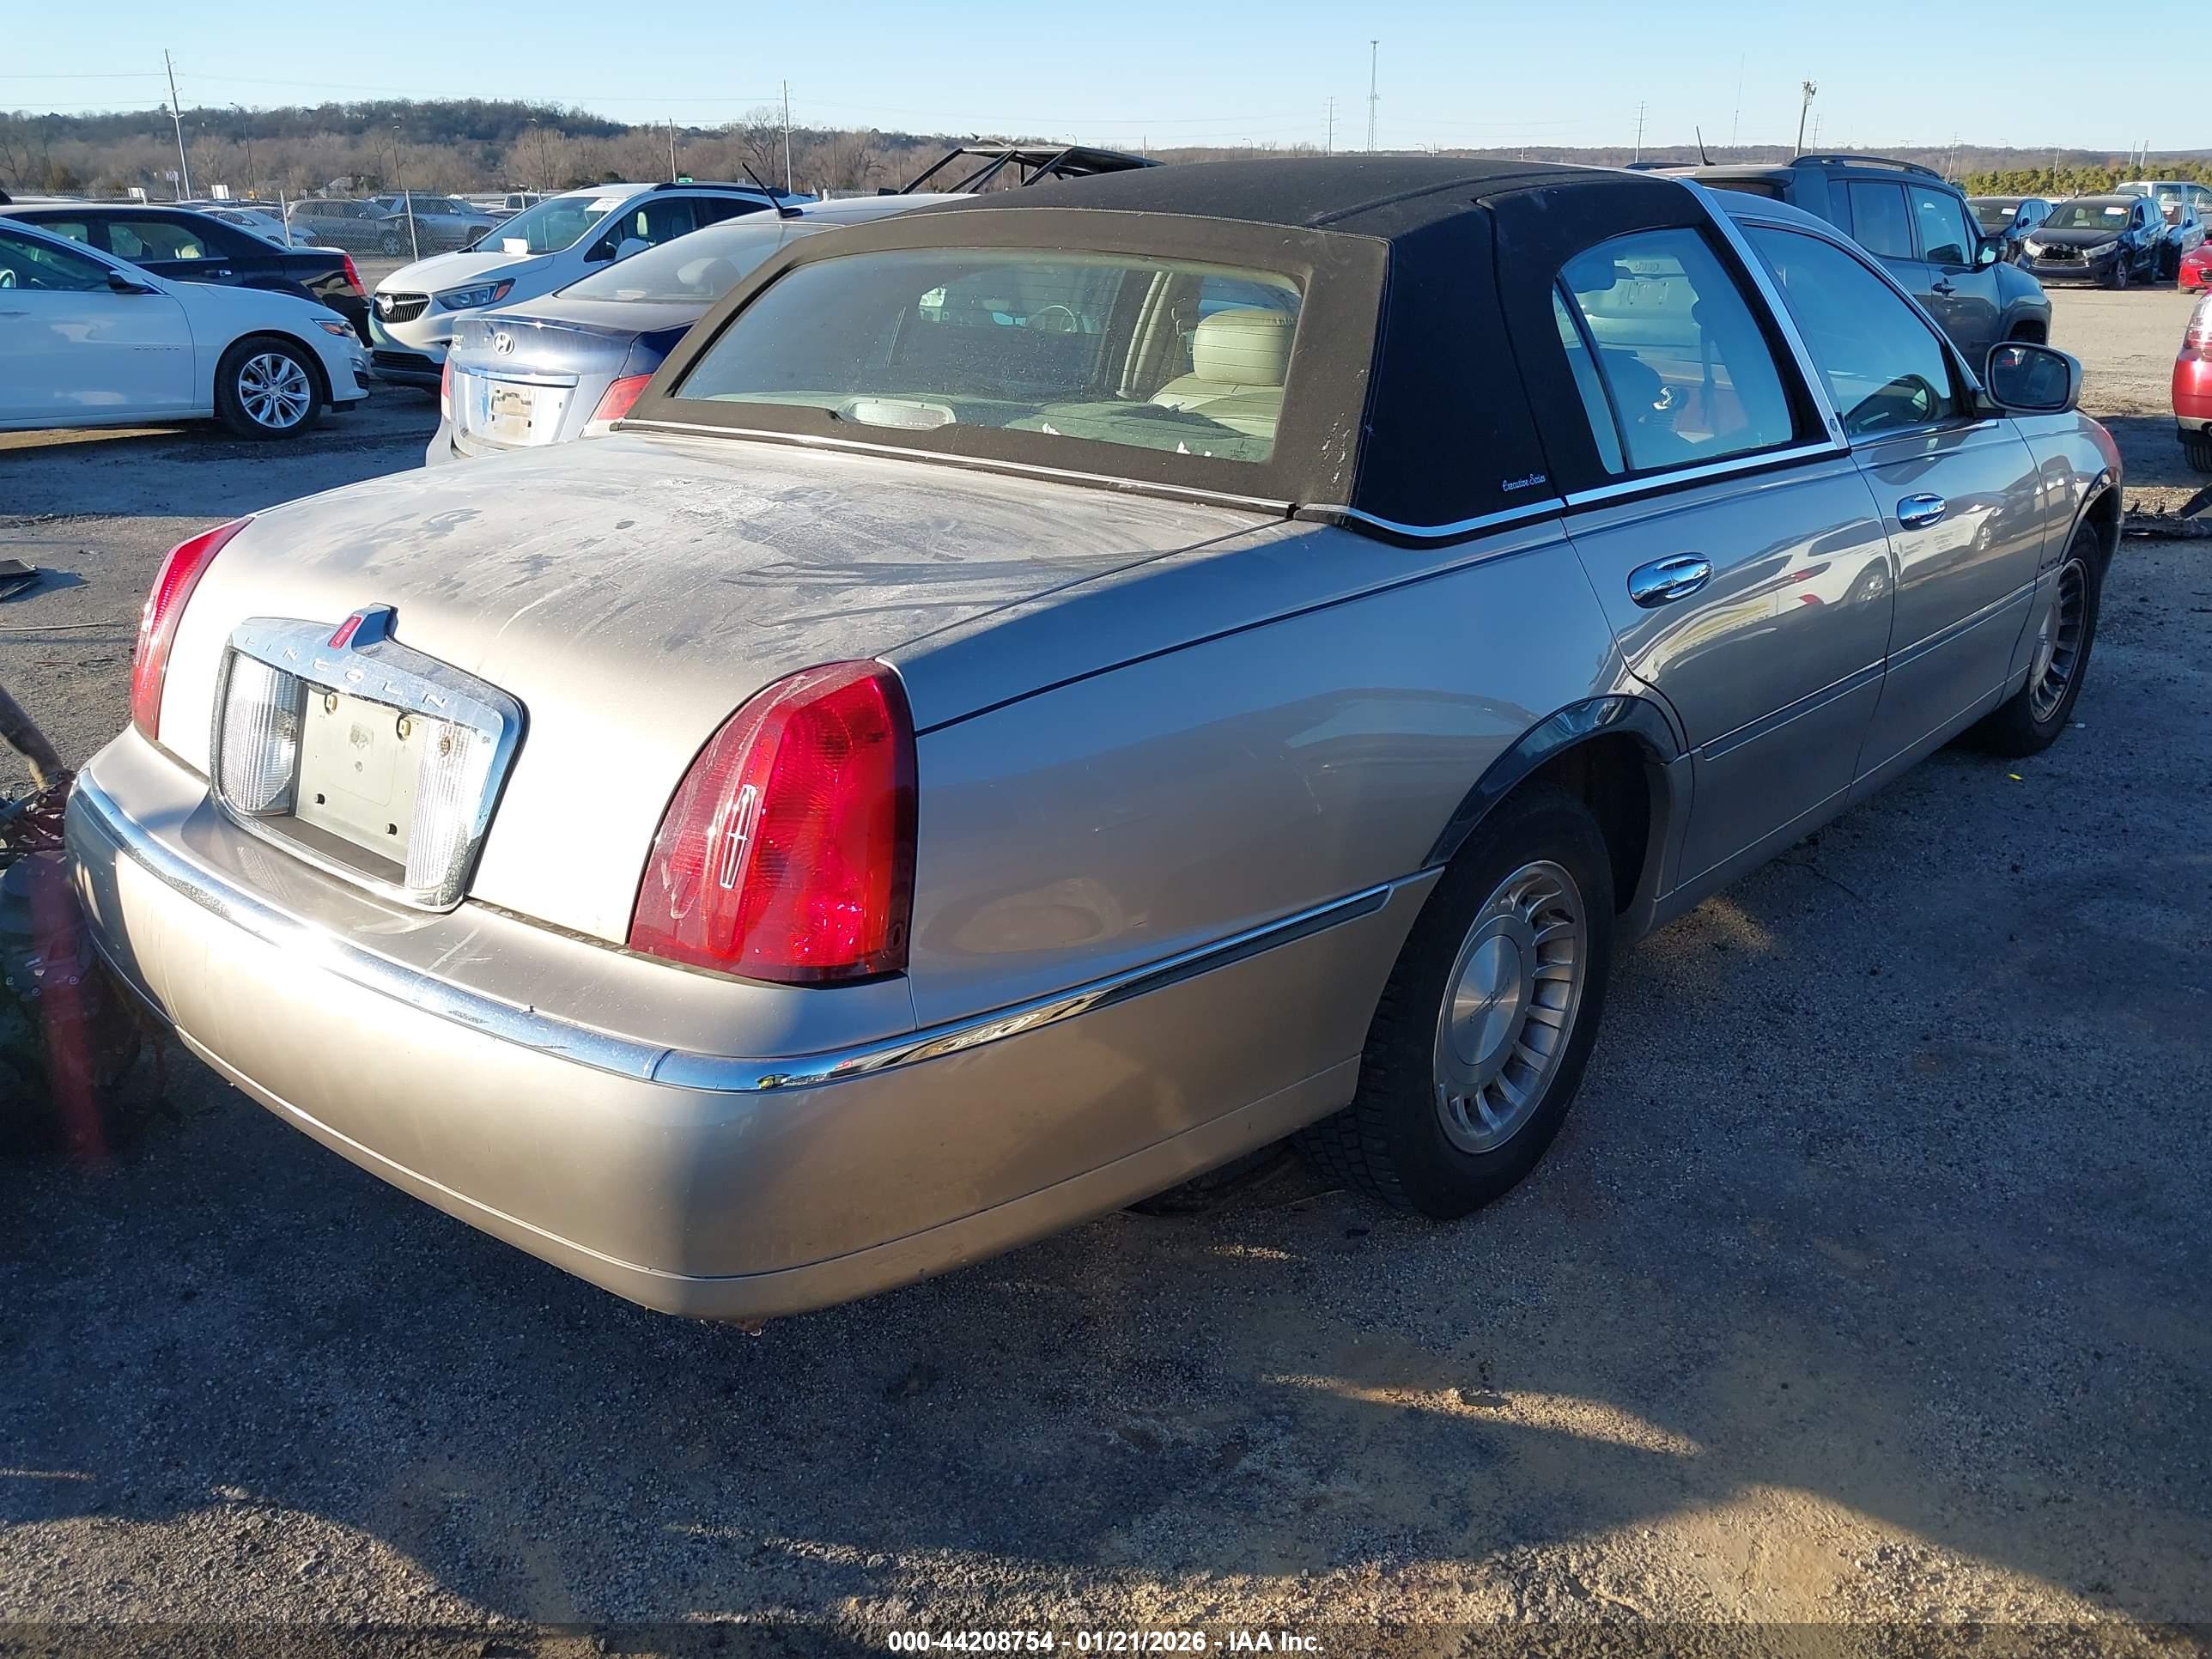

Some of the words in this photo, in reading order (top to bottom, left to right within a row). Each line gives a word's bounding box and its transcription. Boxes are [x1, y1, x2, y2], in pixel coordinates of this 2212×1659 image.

[1502, 479, 1529, 492] Executive
[1529, 473, 1546, 485] Series
[245, 636, 447, 709] LINCOLN
